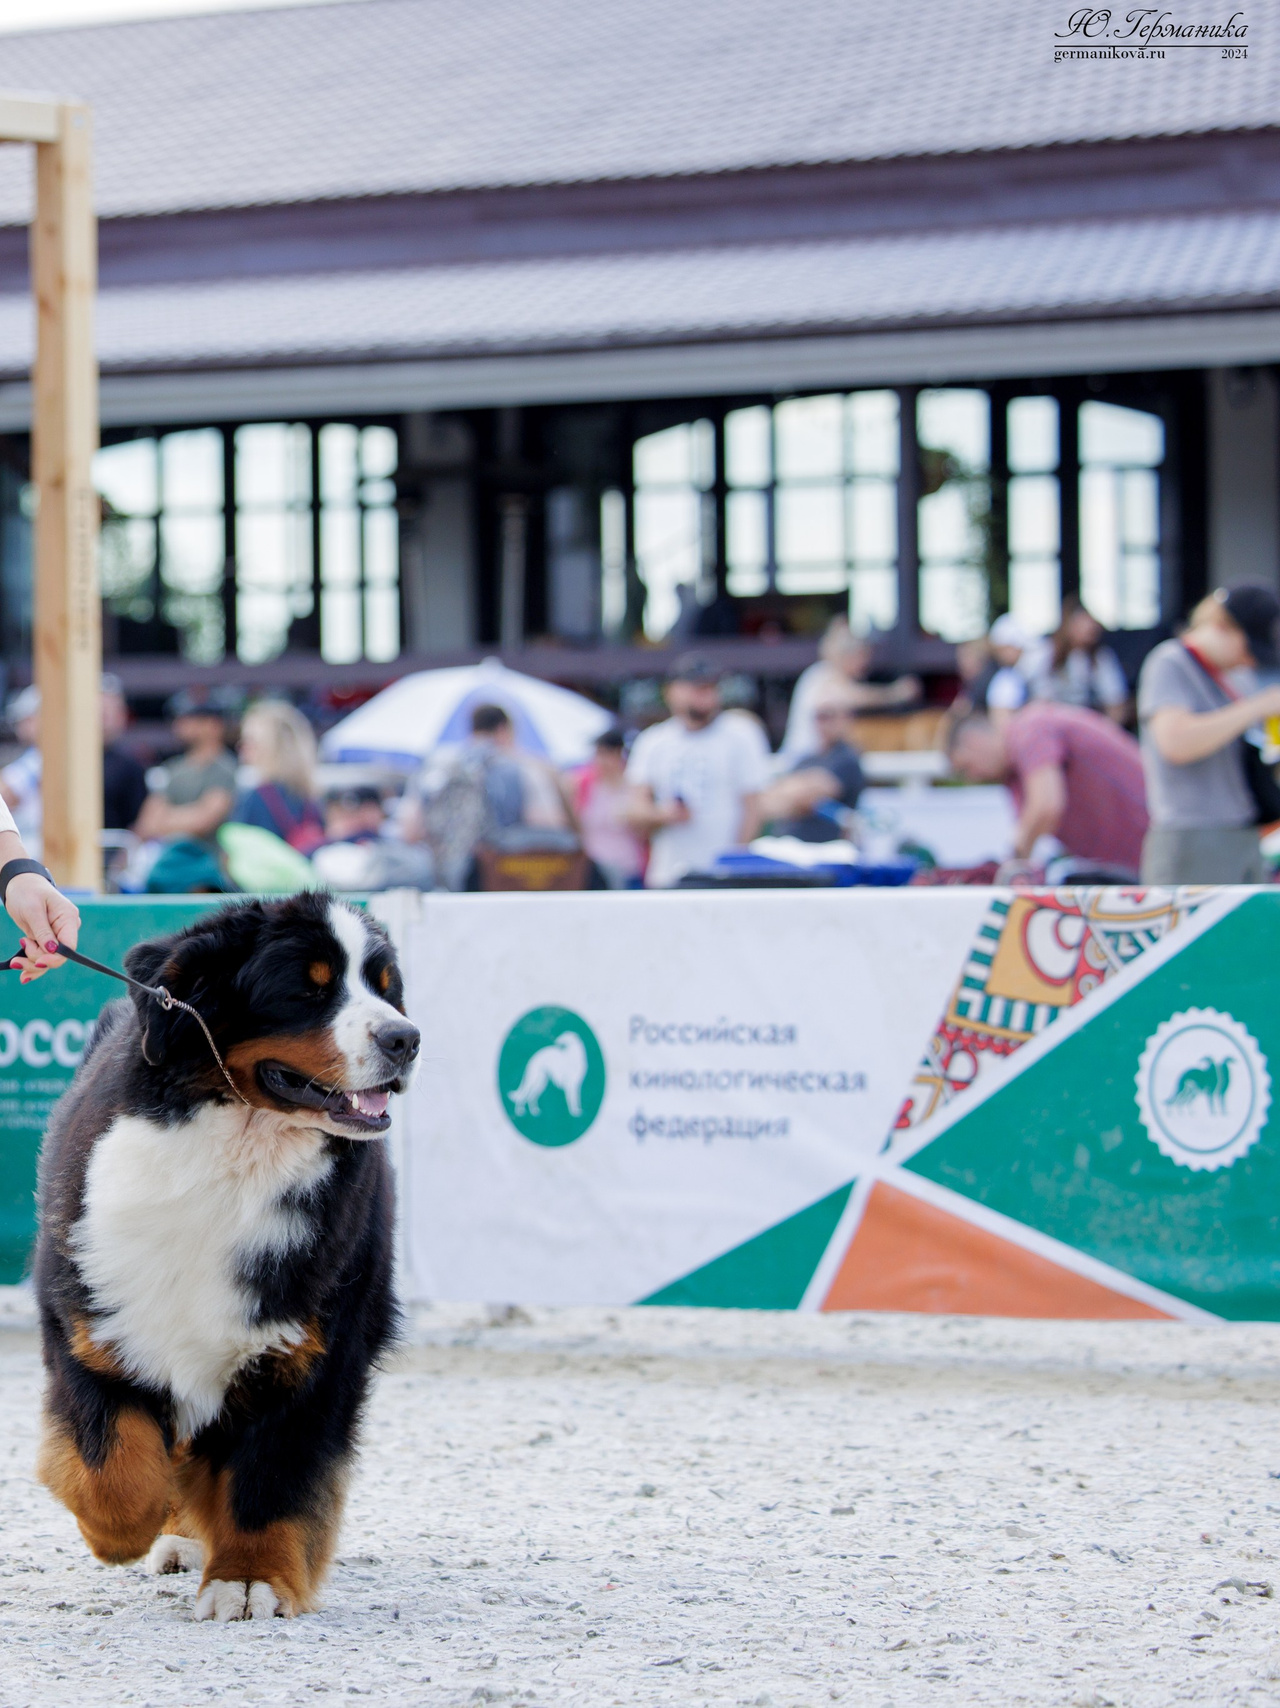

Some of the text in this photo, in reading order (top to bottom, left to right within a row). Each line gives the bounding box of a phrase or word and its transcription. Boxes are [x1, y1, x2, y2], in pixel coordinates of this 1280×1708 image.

[629, 1015, 797, 1044] Российская
[629, 1070, 867, 1093] кинологическая
[628, 1105, 790, 1145] федерация
